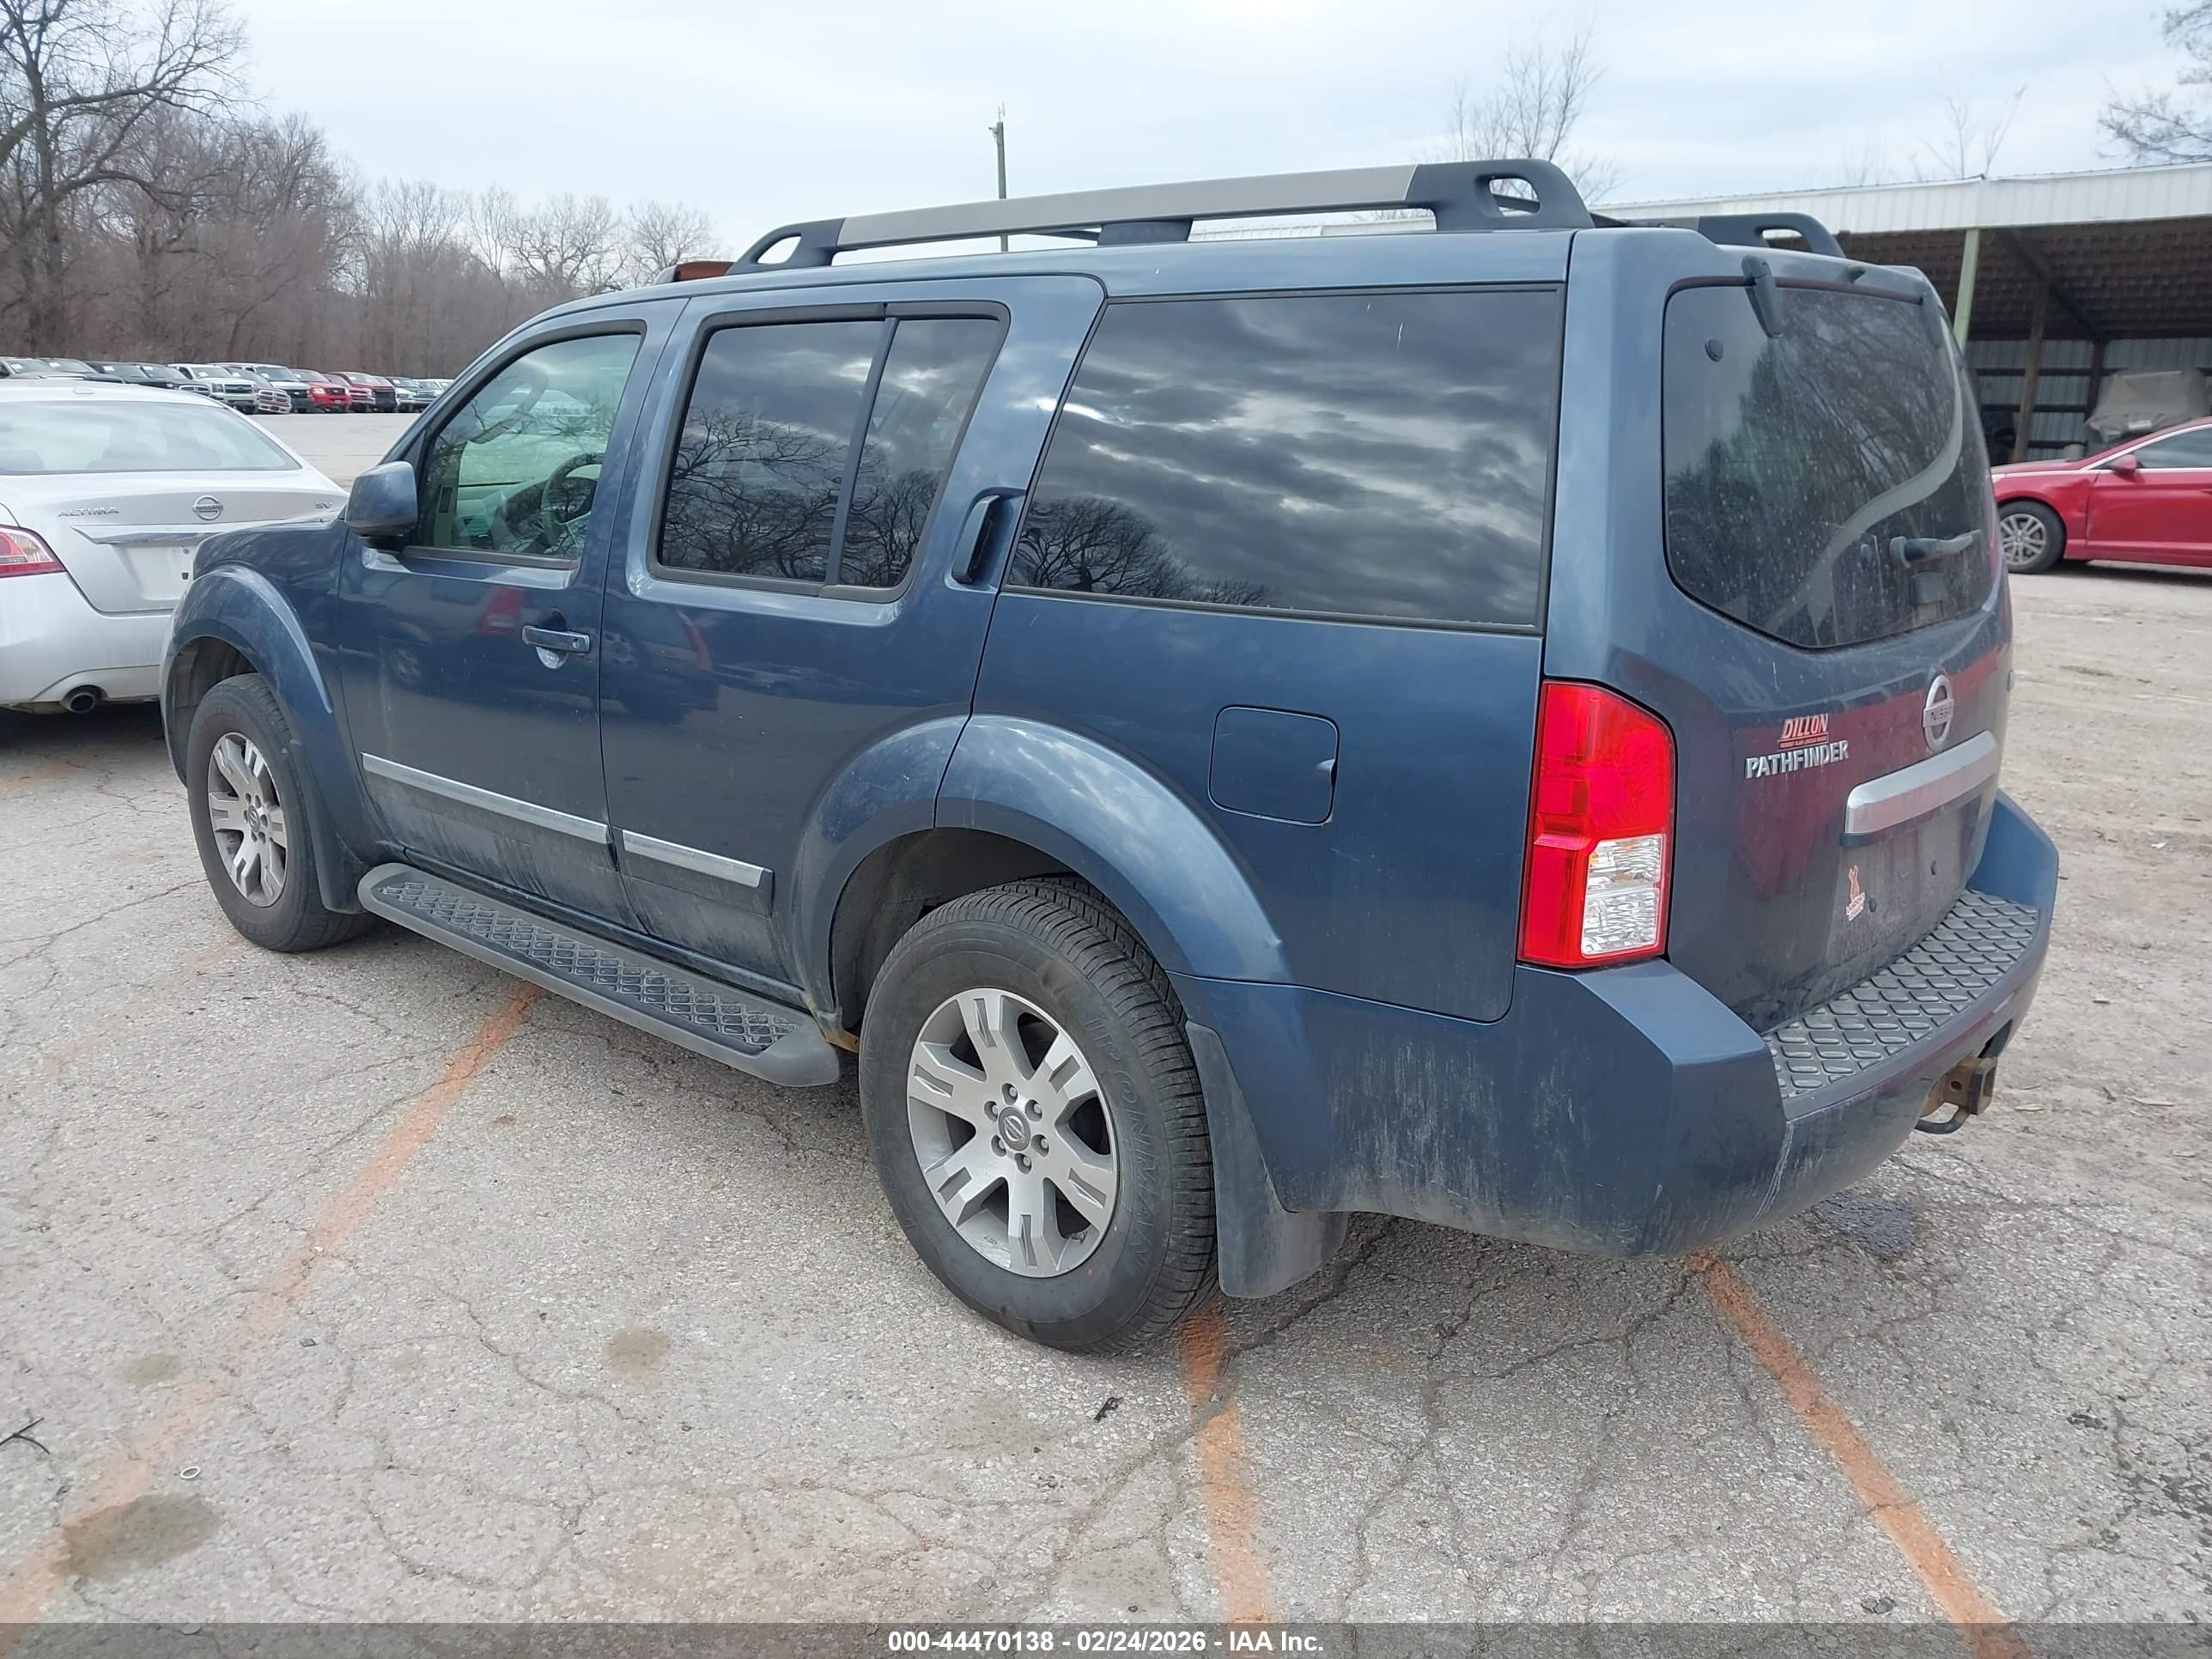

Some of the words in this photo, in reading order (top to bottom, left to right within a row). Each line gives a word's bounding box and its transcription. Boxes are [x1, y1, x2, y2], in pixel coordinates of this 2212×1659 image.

[57, 506, 119, 518] ALTIMA
[1782, 713, 1829, 738] DILLON
[1745, 739, 1850, 779] PATHFINDER
